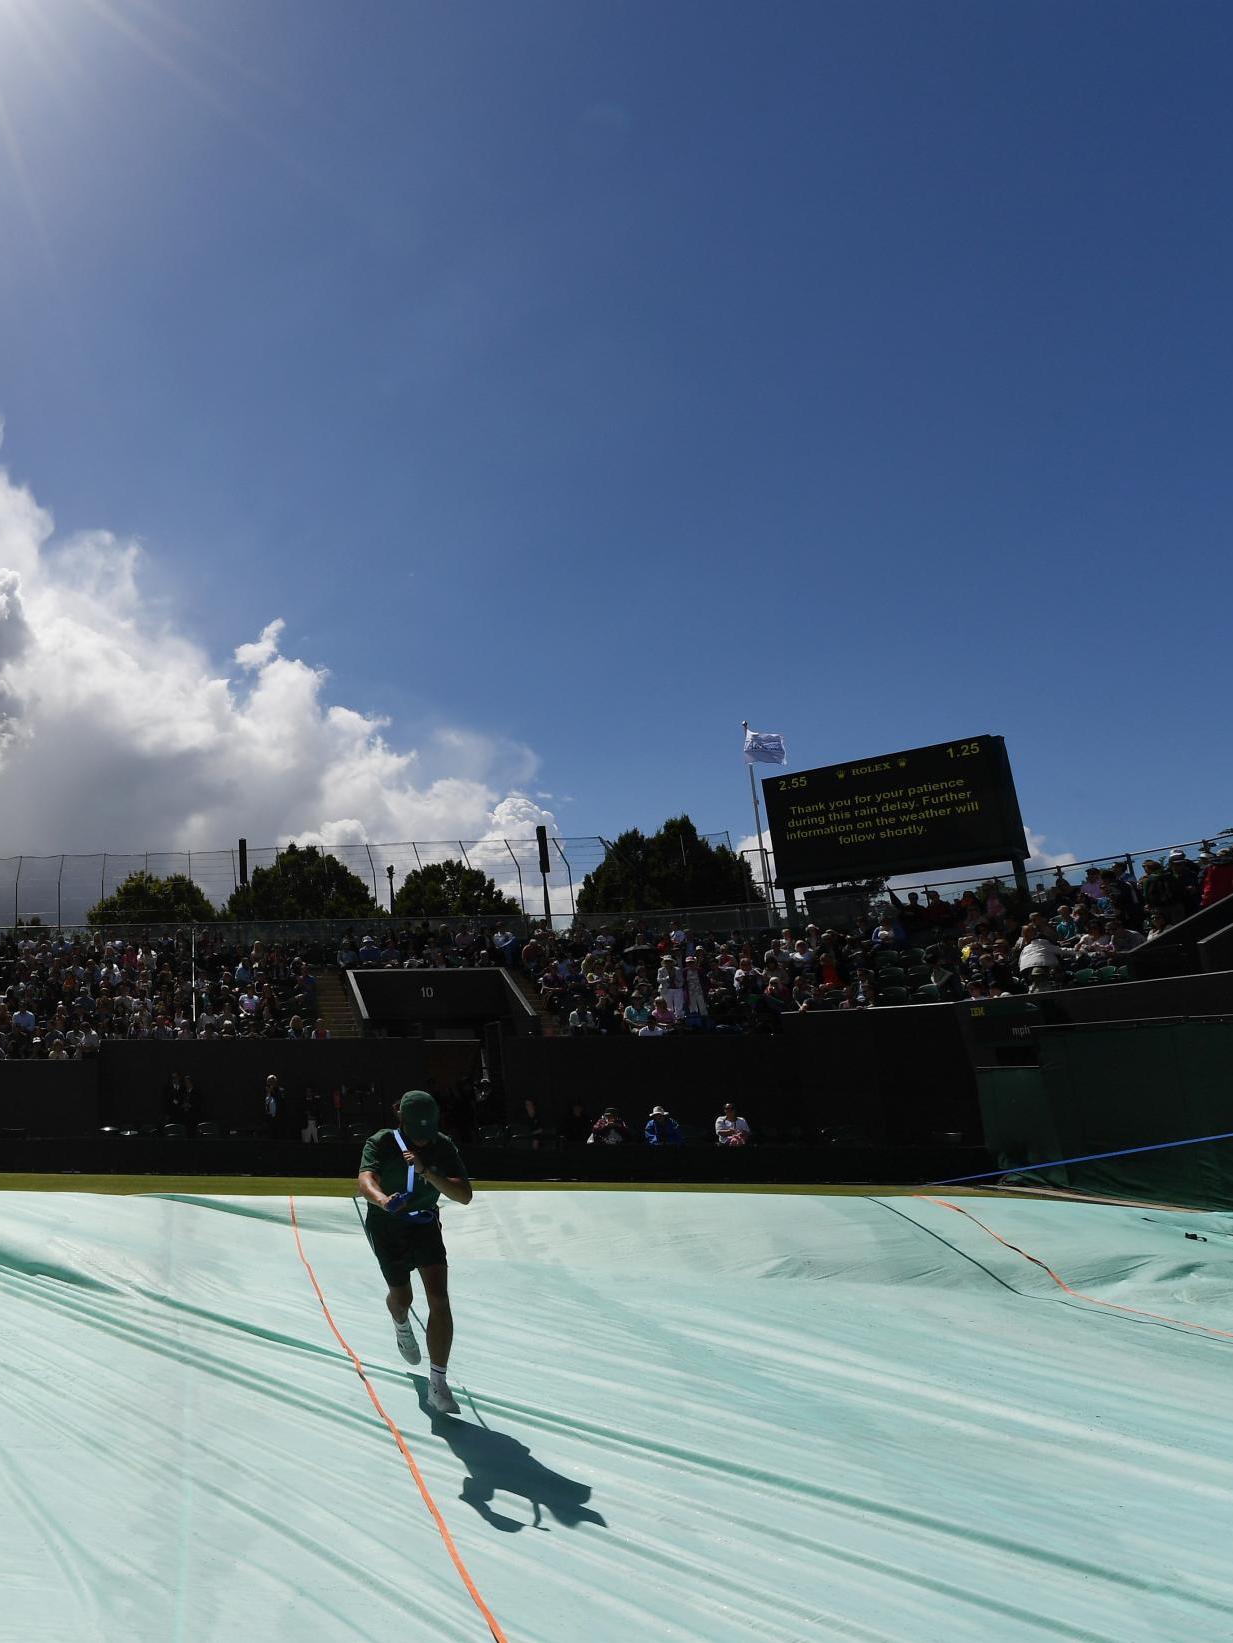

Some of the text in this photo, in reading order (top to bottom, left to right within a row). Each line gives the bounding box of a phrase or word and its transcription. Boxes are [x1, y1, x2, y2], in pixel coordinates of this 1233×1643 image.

[946, 742, 980, 759] 1.25
[851, 761, 892, 776] ROLEX
[778, 776, 807, 791] 2.55
[790, 778, 965, 816] Thank you for your patience
[787, 790, 971, 828] during this rain delay. Further
[786, 801, 979, 840] information on the weather will
[838, 824, 927, 845] follow shortly.
[421, 986, 433, 998] 10
[970, 1007, 985, 1017] IBM
